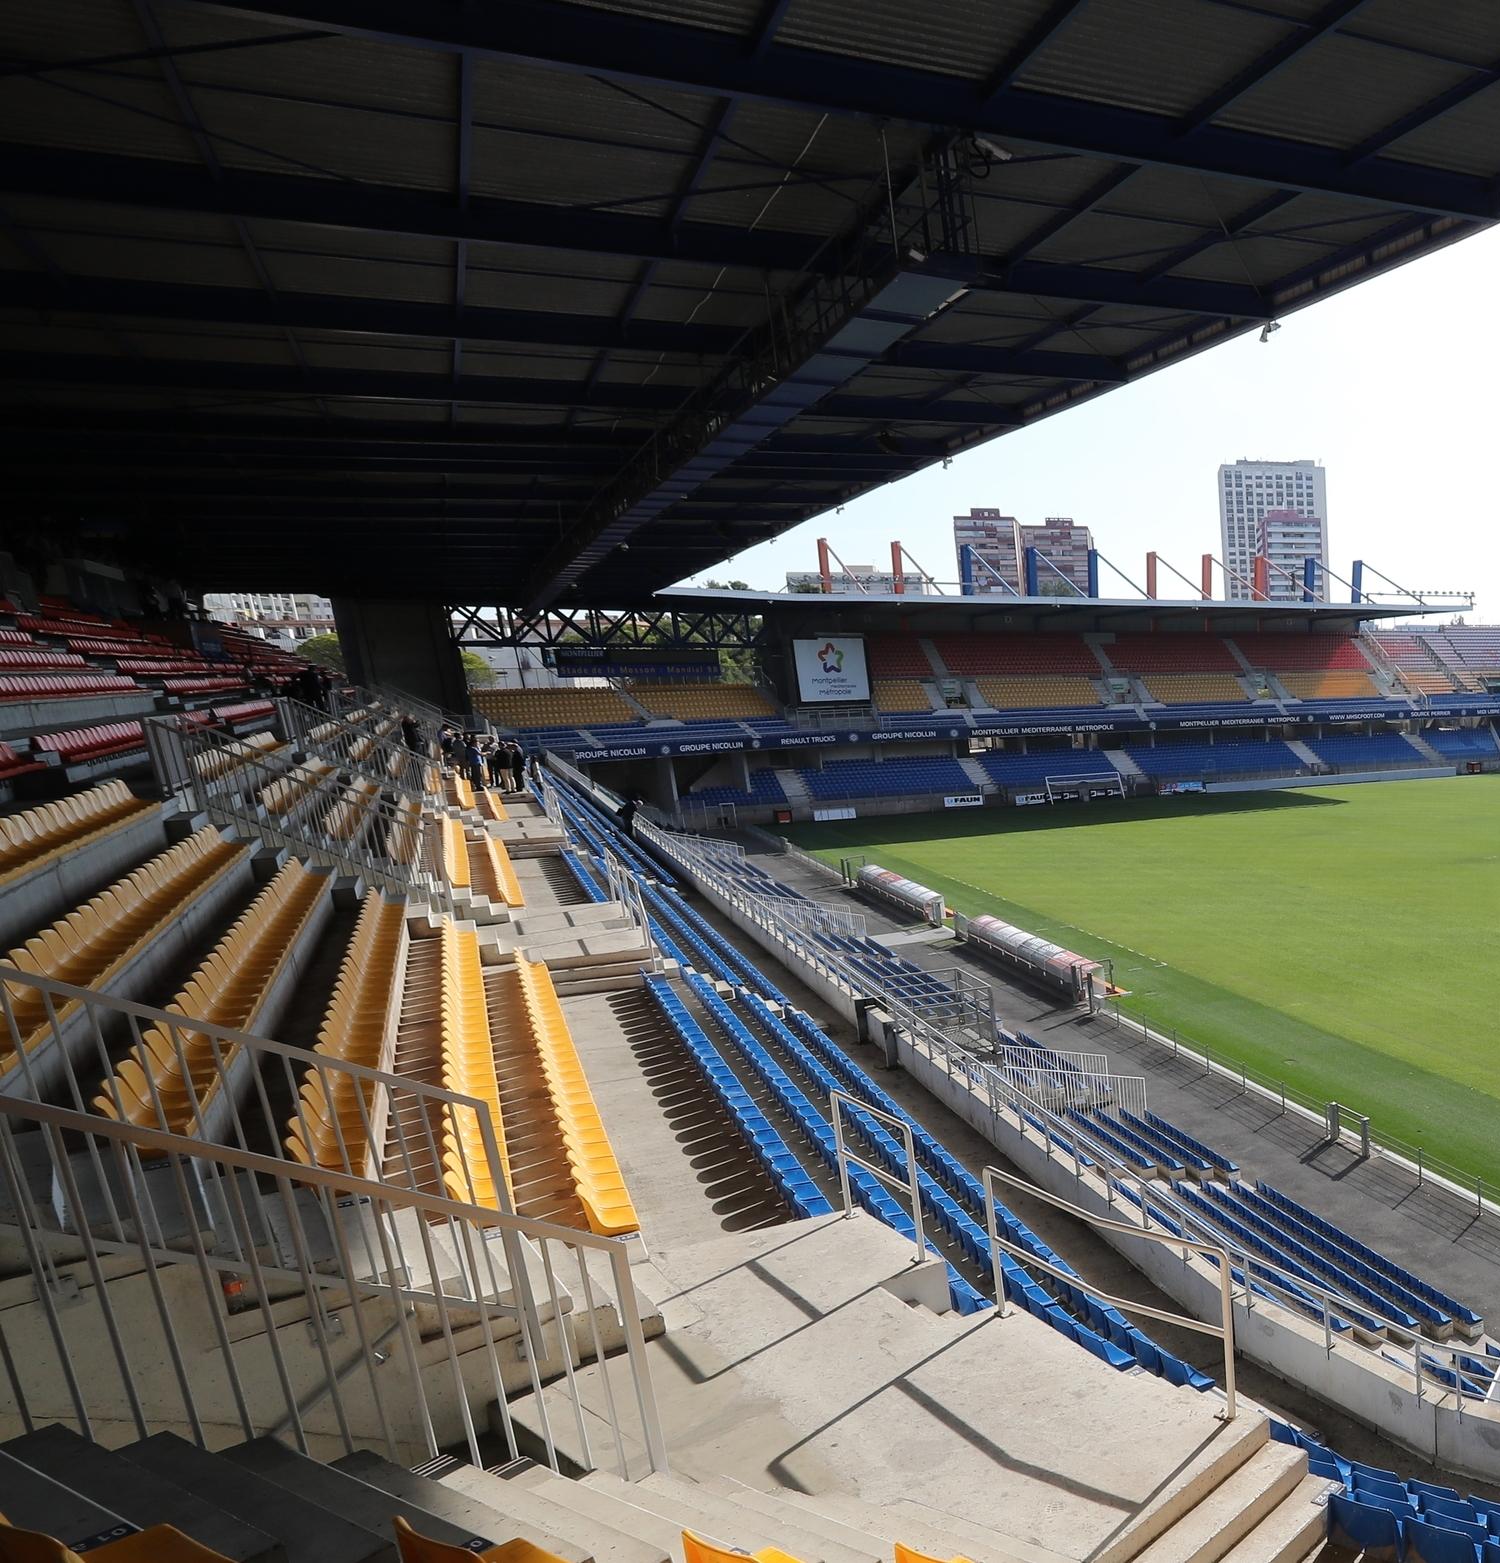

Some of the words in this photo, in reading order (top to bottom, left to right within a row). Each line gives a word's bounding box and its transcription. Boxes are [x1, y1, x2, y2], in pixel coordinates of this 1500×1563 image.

[591, 666, 605, 675] de
[1179, 719, 1220, 727] MONTPELLIER
[1221, 717, 1264, 726] MEDITERRANEE
[871, 732, 903, 740] GROUPE
[904, 730, 937, 738] NICOLLIN
[971, 727, 1019, 736] MONTPELLIER
[1021, 725, 1073, 734] MEDITERRANEE
[1075, 724, 1115, 732] METROPOLE
[780, 737, 810, 745] RENAULT
[811, 735, 836, 743] TRUCKS
[679, 743, 711, 752] GROUPE
[712, 741, 744, 750] NICOLLIN
[610, 747, 646, 757] NICOLLIN
[954, 796, 981, 804] FAUN
